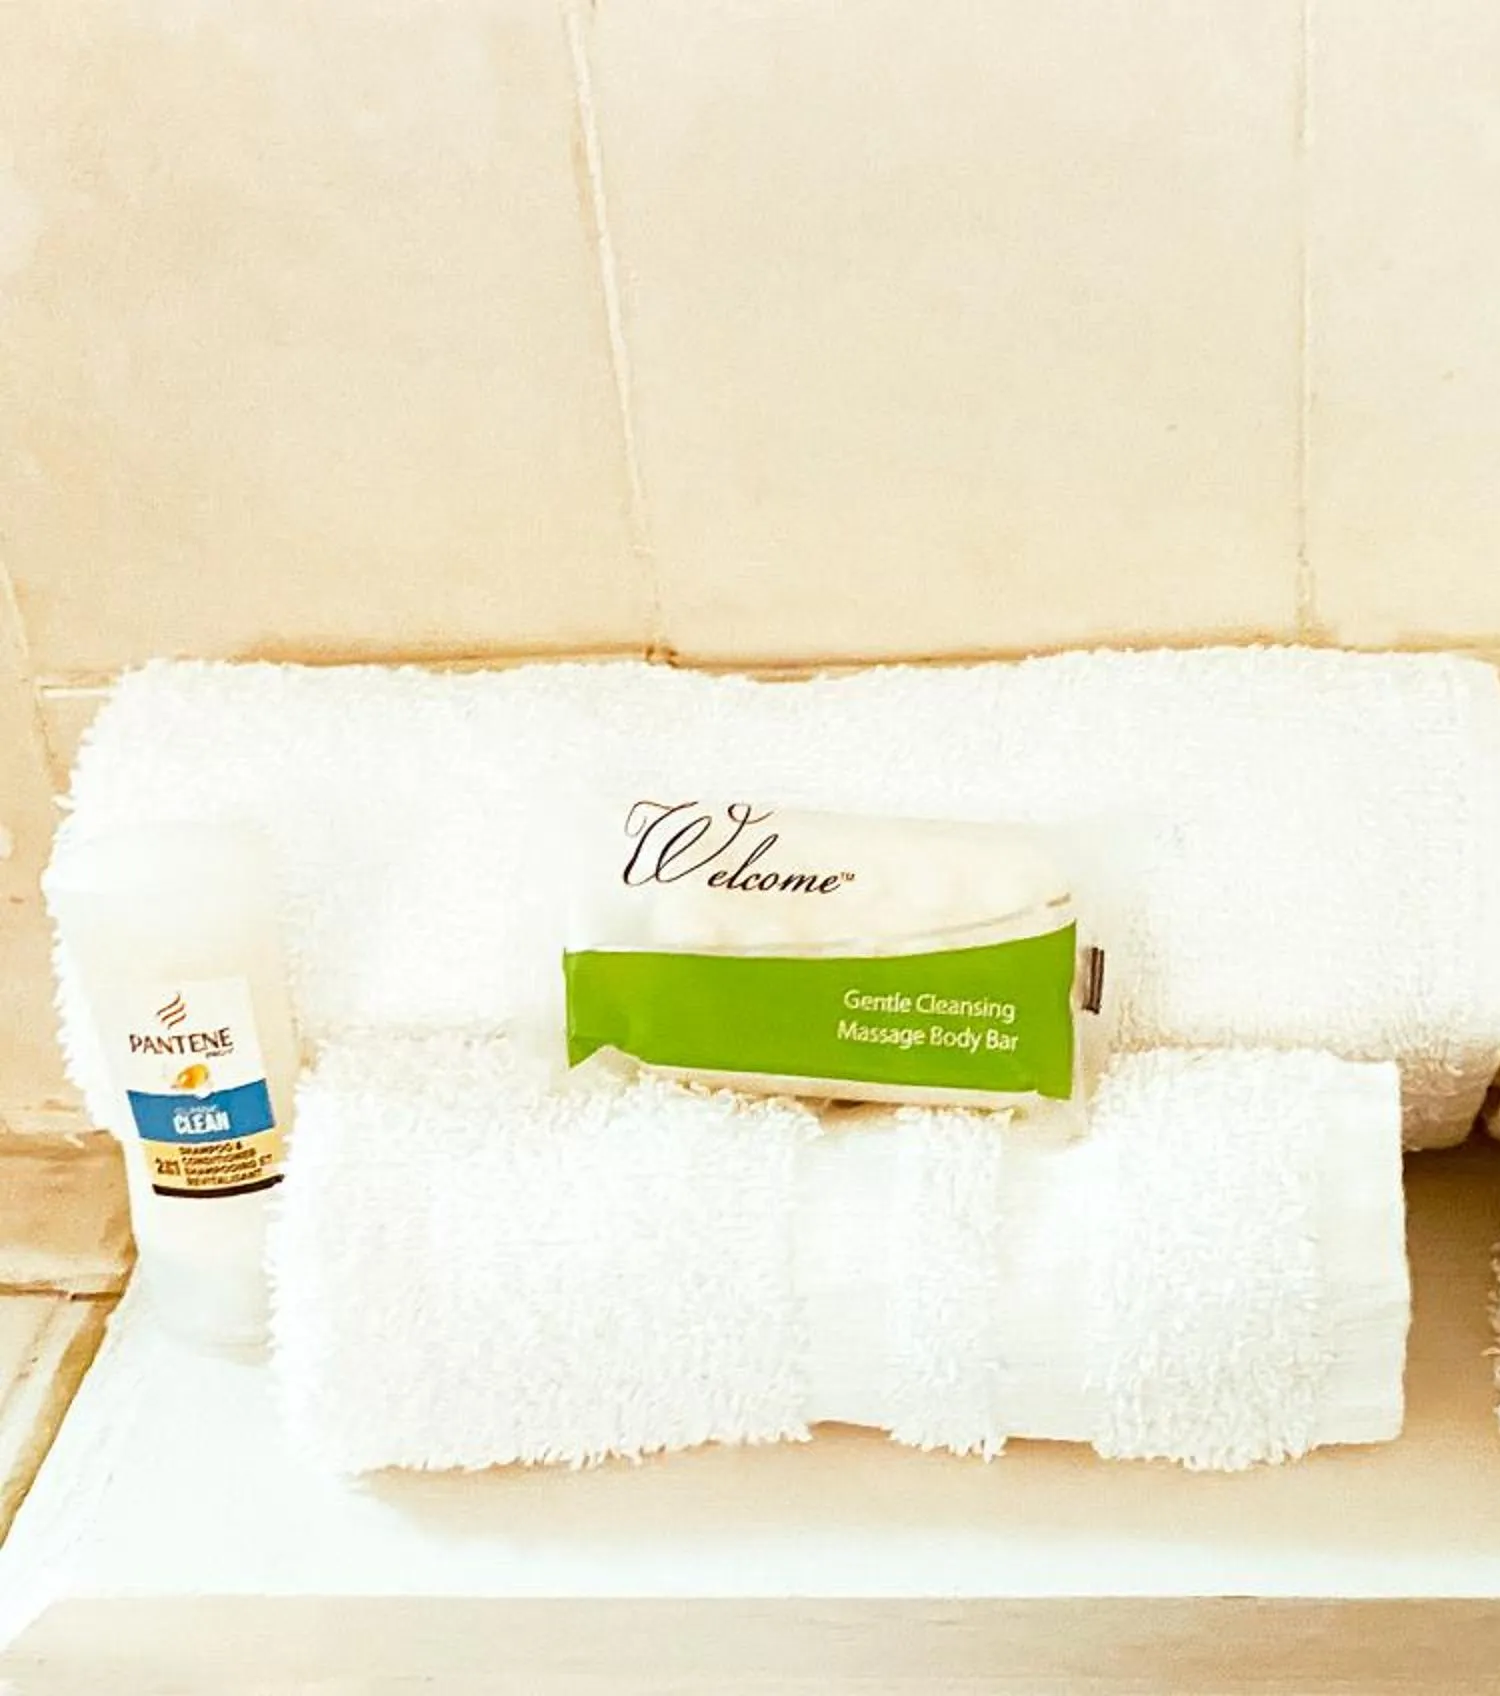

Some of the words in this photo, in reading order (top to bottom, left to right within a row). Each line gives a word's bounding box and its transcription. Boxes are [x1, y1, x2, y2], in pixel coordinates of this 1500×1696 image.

[622, 800, 840, 894] Welcome
[844, 989, 912, 1013] Gentle
[915, 993, 1016, 1024] Cleansing
[129, 1027, 234, 1055] PANTENE
[837, 1019, 926, 1049] Massage
[929, 1025, 983, 1054] Body
[985, 1028, 1019, 1051] Bar
[173, 1111, 230, 1135] CLEAN
